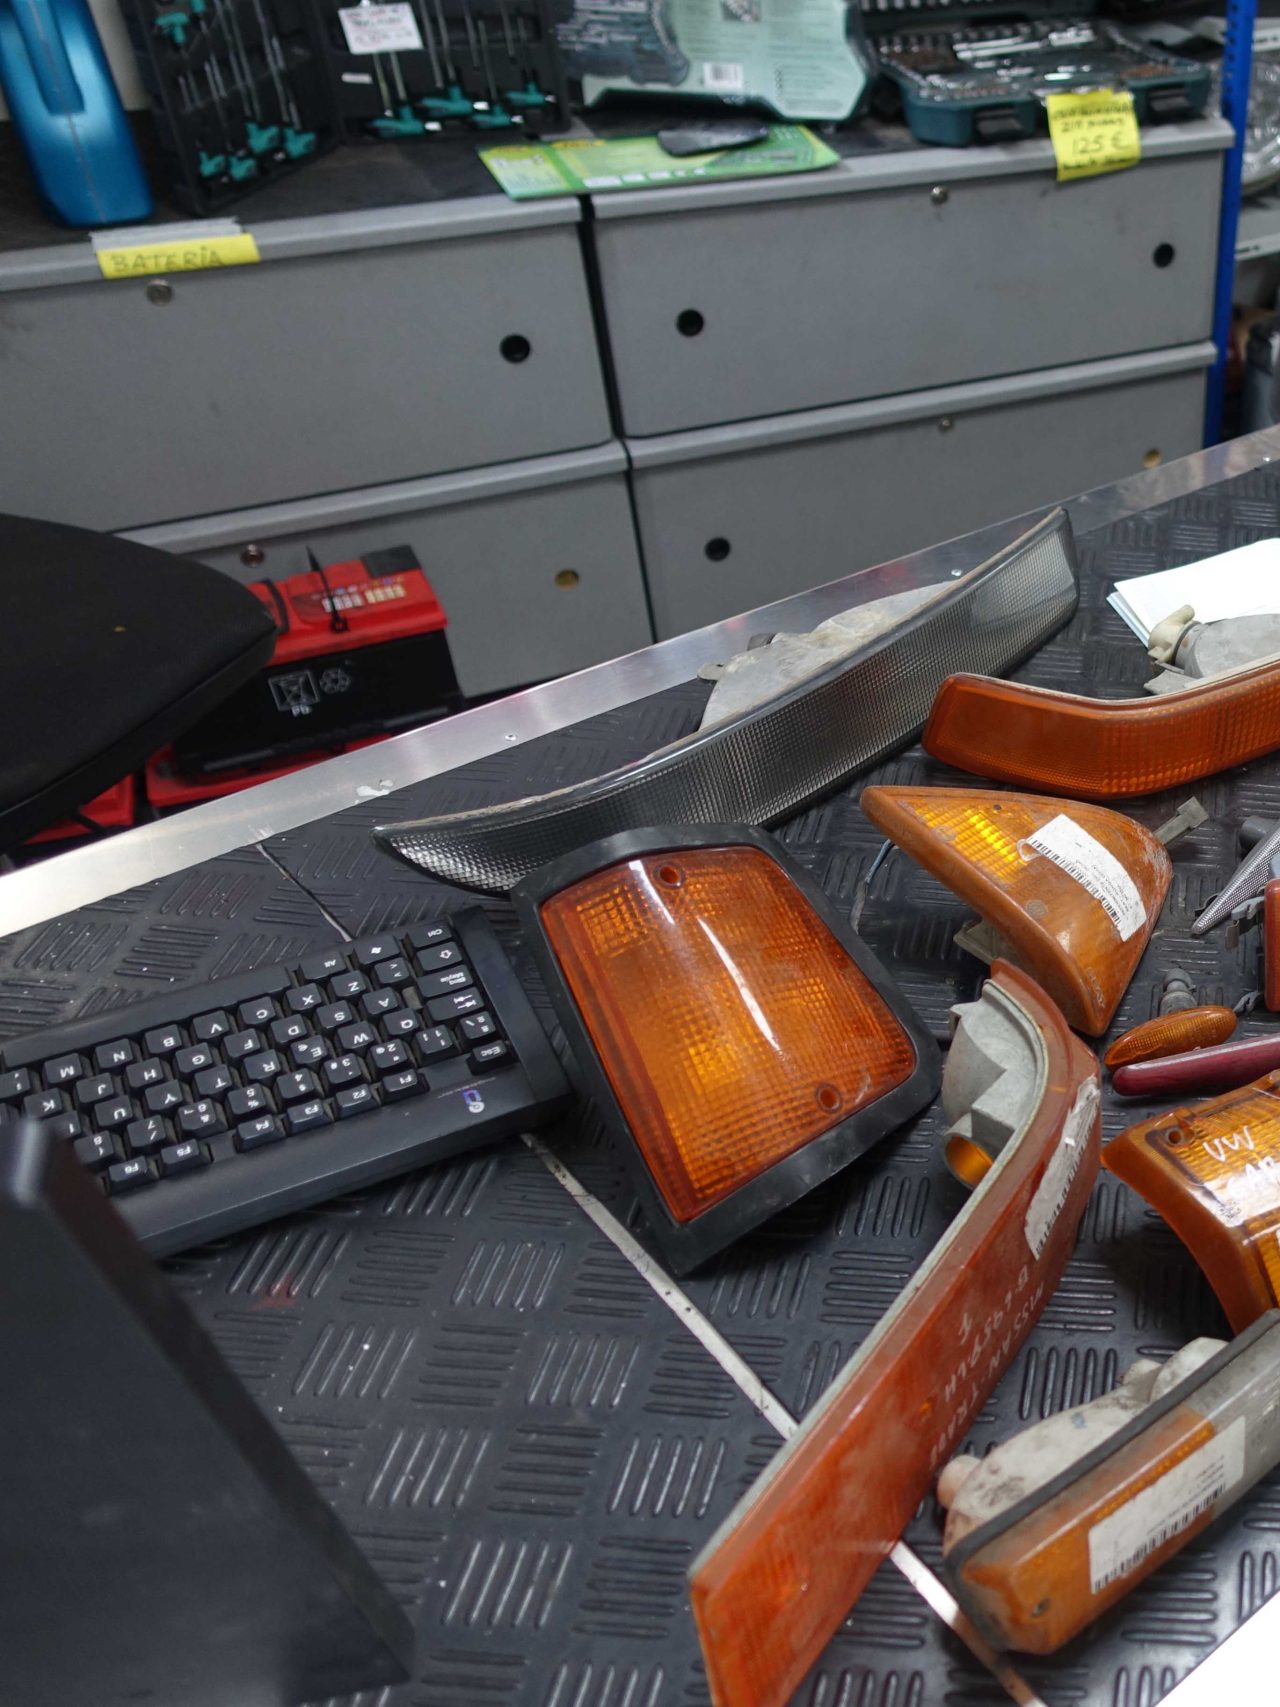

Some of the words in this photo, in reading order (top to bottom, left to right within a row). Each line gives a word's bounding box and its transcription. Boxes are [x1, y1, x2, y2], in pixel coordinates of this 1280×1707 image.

[1073, 136, 1105, 156] 125
[348, 981, 360, 992] Z
[302, 994, 314, 1006] X
[378, 997, 390, 1008] A
[256, 1009, 269, 1019] C
[334, 1011, 346, 1021] S
[210, 1023, 223, 1034] V
[400, 1019, 414, 1029] Q
[287, 1025, 300, 1036] D
[162, 1036, 175, 1048] B
[244, 1039, 254, 1050] F
[353, 1032, 369, 1045] W
[112, 1050, 126, 1063] N
[310, 1046, 323, 1058] E
[191, 1054, 206, 1065] G
[59, 1065, 75, 1078] M
[262, 1061, 276, 1072] R
[143, 1068, 157, 1081] H
[215, 1077, 226, 1089] T
[97, 1084, 106, 1095] J
[164, 1093, 177, 1105] Y
[42, 1099, 55, 1112] K
[113, 1108, 127, 1120] U
